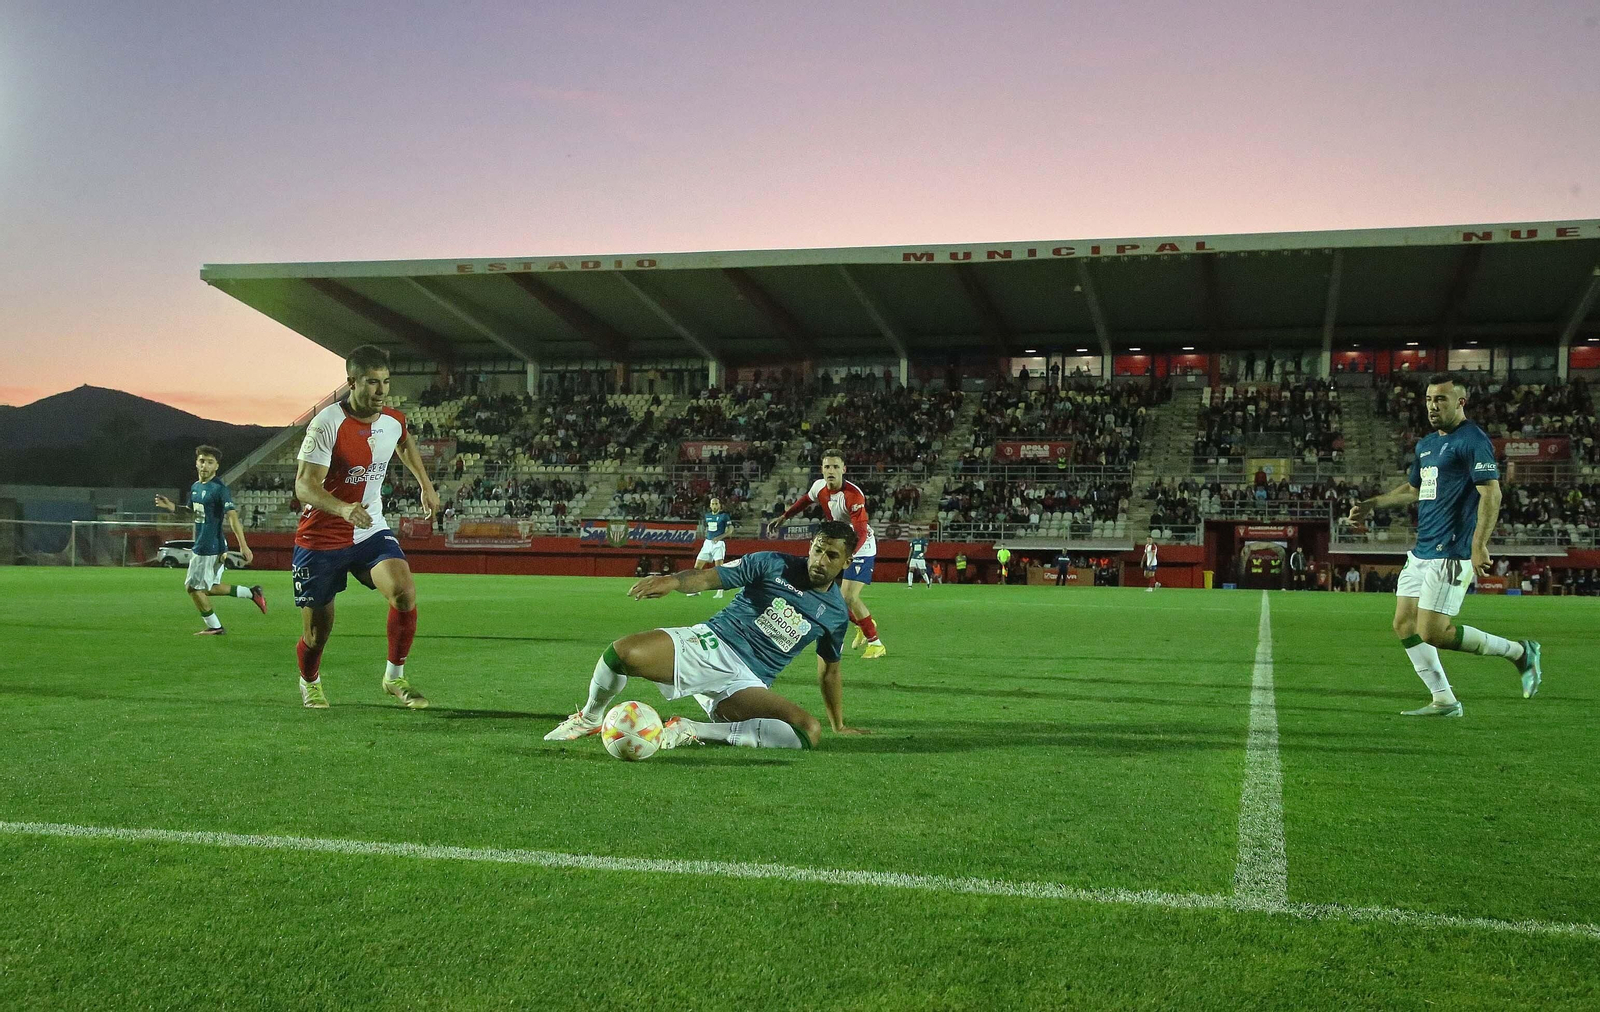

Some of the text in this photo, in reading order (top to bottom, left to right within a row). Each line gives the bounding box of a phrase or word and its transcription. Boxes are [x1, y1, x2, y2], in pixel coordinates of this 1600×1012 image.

[456, 226, 1600, 273] ESTADIO MUNICIPAL NUE
[774, 577, 804, 597] GIVOVA
